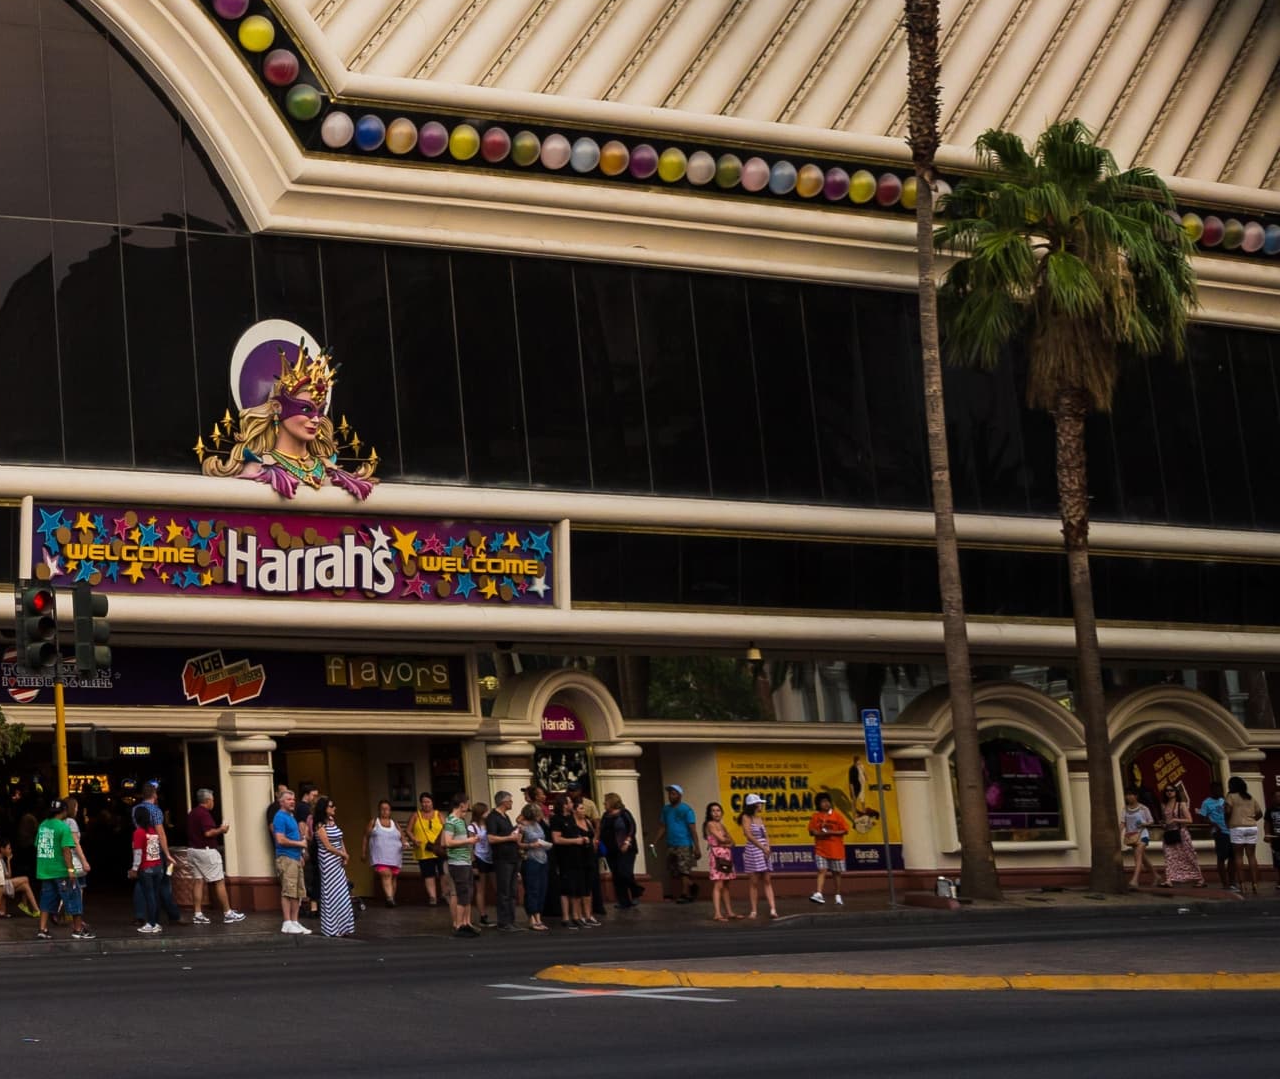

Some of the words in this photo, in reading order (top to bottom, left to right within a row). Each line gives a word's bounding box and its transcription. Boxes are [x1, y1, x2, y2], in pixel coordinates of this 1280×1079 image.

[66, 543, 195, 564] WELCOME
[422, 555, 539, 575] WELCOME
[328, 656, 449, 687] flavors
[730, 775, 786, 789] DEFENDING
[789, 775, 809, 789] THE
